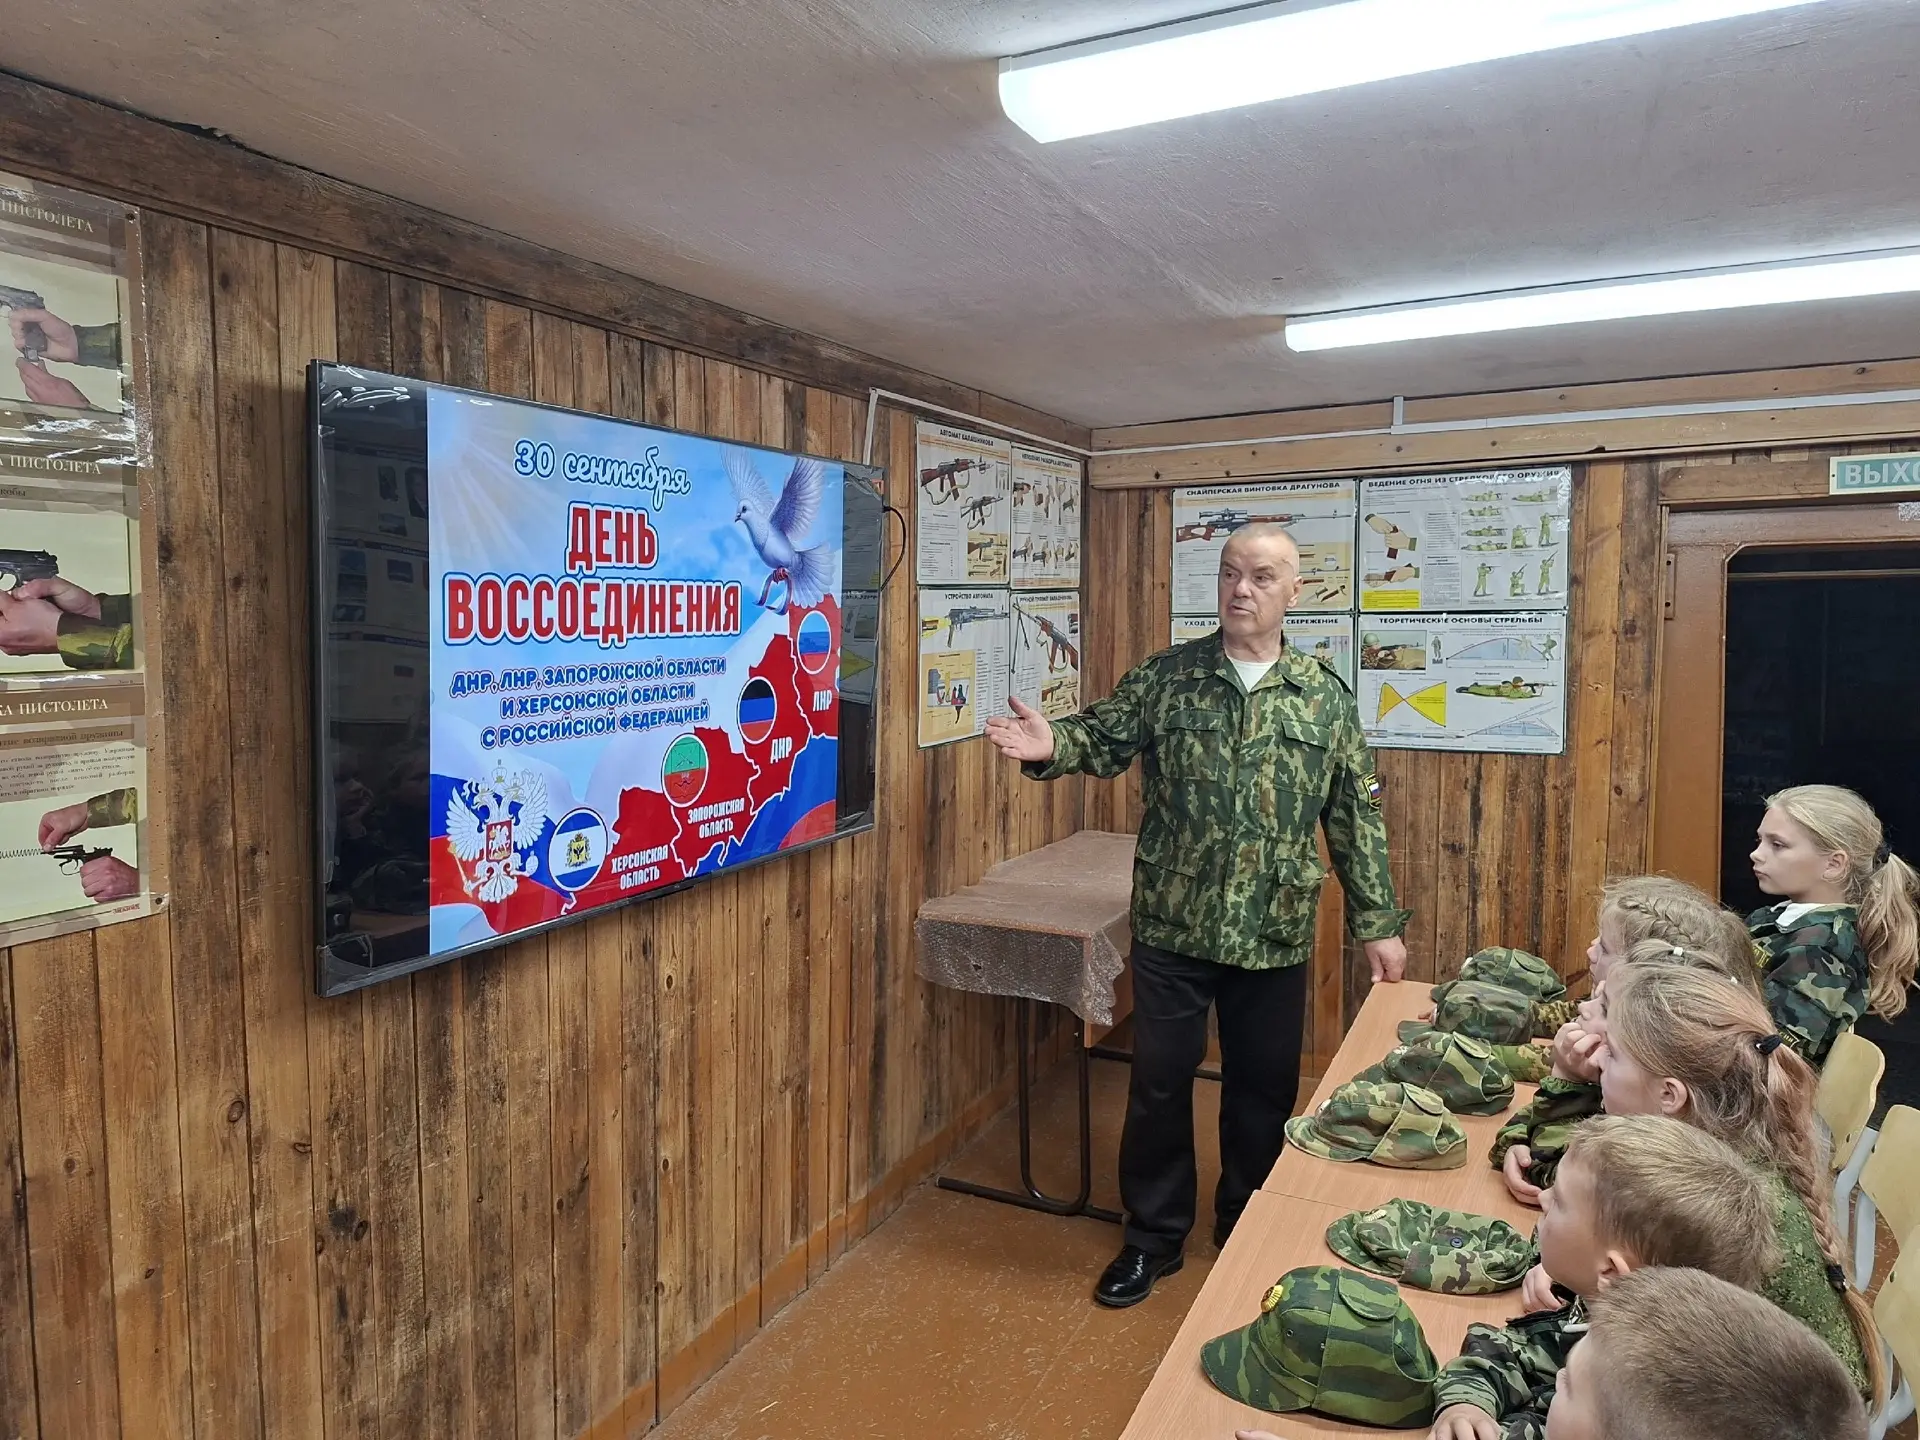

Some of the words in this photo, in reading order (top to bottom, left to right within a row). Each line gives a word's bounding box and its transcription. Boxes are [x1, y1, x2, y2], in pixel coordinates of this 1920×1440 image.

[1, 200, 93, 233] ПИСТОЛЕТА
[10, 455, 102, 474] ПИСТОЛЕТА
[515, 439, 555, 478] 30
[563, 446, 691, 511] сентября
[1186, 487, 1242, 496] СНАЙПЕРСКАЯ
[1244, 485, 1288, 493] ВИНТОВКА
[1290, 482, 1340, 490] ДРАГУНОВА
[1368, 479, 1406, 488] ВЕДЕНИЕ
[1409, 477, 1432, 485] ОГНЯ
[1449, 472, 1514, 483] СТРЕЛКОВГО
[566, 502, 659, 575] ДЕНЬ
[443, 573, 742, 648] ВОССОЕДИНЕНИЯ
[450, 672, 497, 698] ДНР,
[499, 668, 542, 693] ЛНР,
[543, 660, 665, 688] ЗАПОРОЖСКОЙ
[666, 656, 727, 678] ОБЛАСТИ
[19, 698, 109, 715] ПИСТОЛЕТА
[501, 694, 516, 718] И
[517, 688, 630, 716] ХЕРСОНСКОЙ
[631, 683, 696, 706] ОБЛАСТИ
[813, 689, 832, 712] ЛНР
[481, 728, 497, 749] С
[498, 715, 618, 746] РОССИЙСКОЙ
[619, 700, 710, 730] ФЕДЕРАЦИЕЙ
[770, 737, 793, 764] ДНР
[687, 798, 745, 824] ЗАПОРОЖСКАЯ
[699, 819, 734, 838] ОБЛАСТЬ
[611, 845, 669, 874] ХЕРСОНСКАЯ
[620, 868, 660, 890] ОБЛАСТЬ
